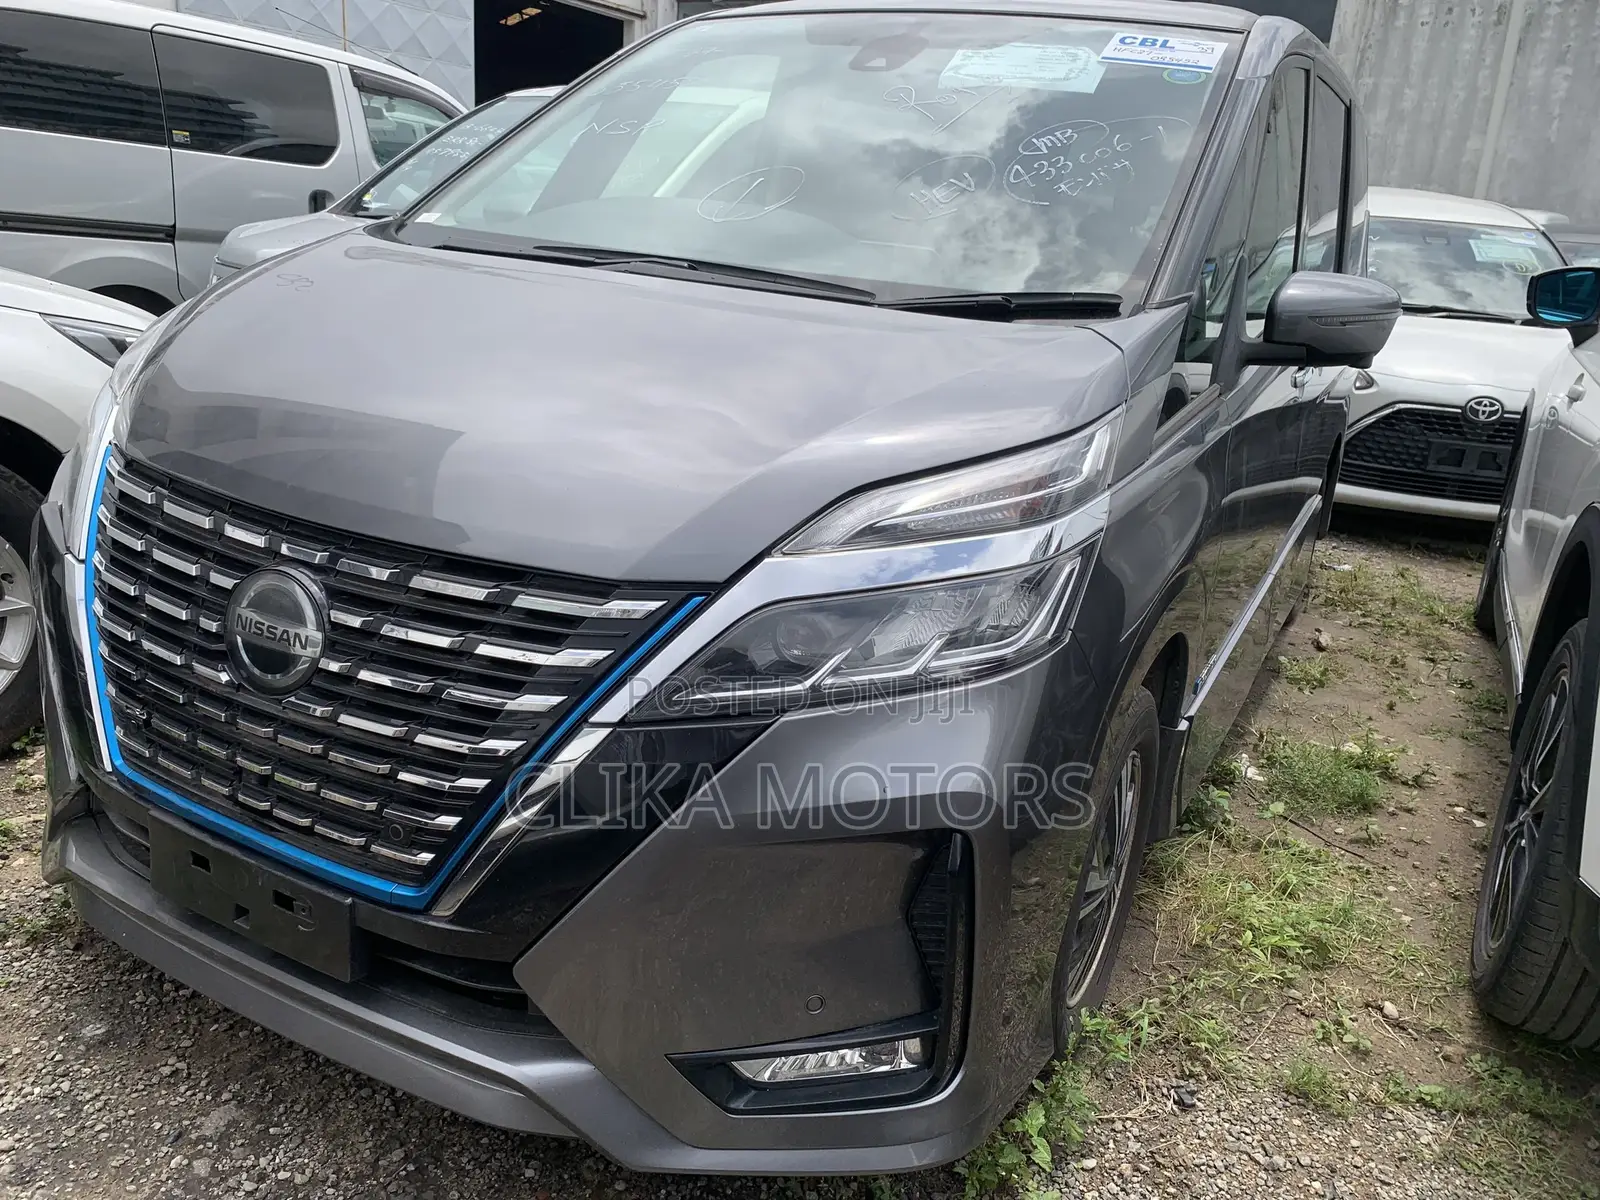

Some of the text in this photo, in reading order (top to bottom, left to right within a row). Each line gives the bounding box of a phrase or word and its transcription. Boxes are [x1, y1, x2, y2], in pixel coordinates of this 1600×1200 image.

[1118, 35, 1176, 50] CBL
[909, 172, 976, 216] HEV
[235, 613, 310, 651] NISSAN
